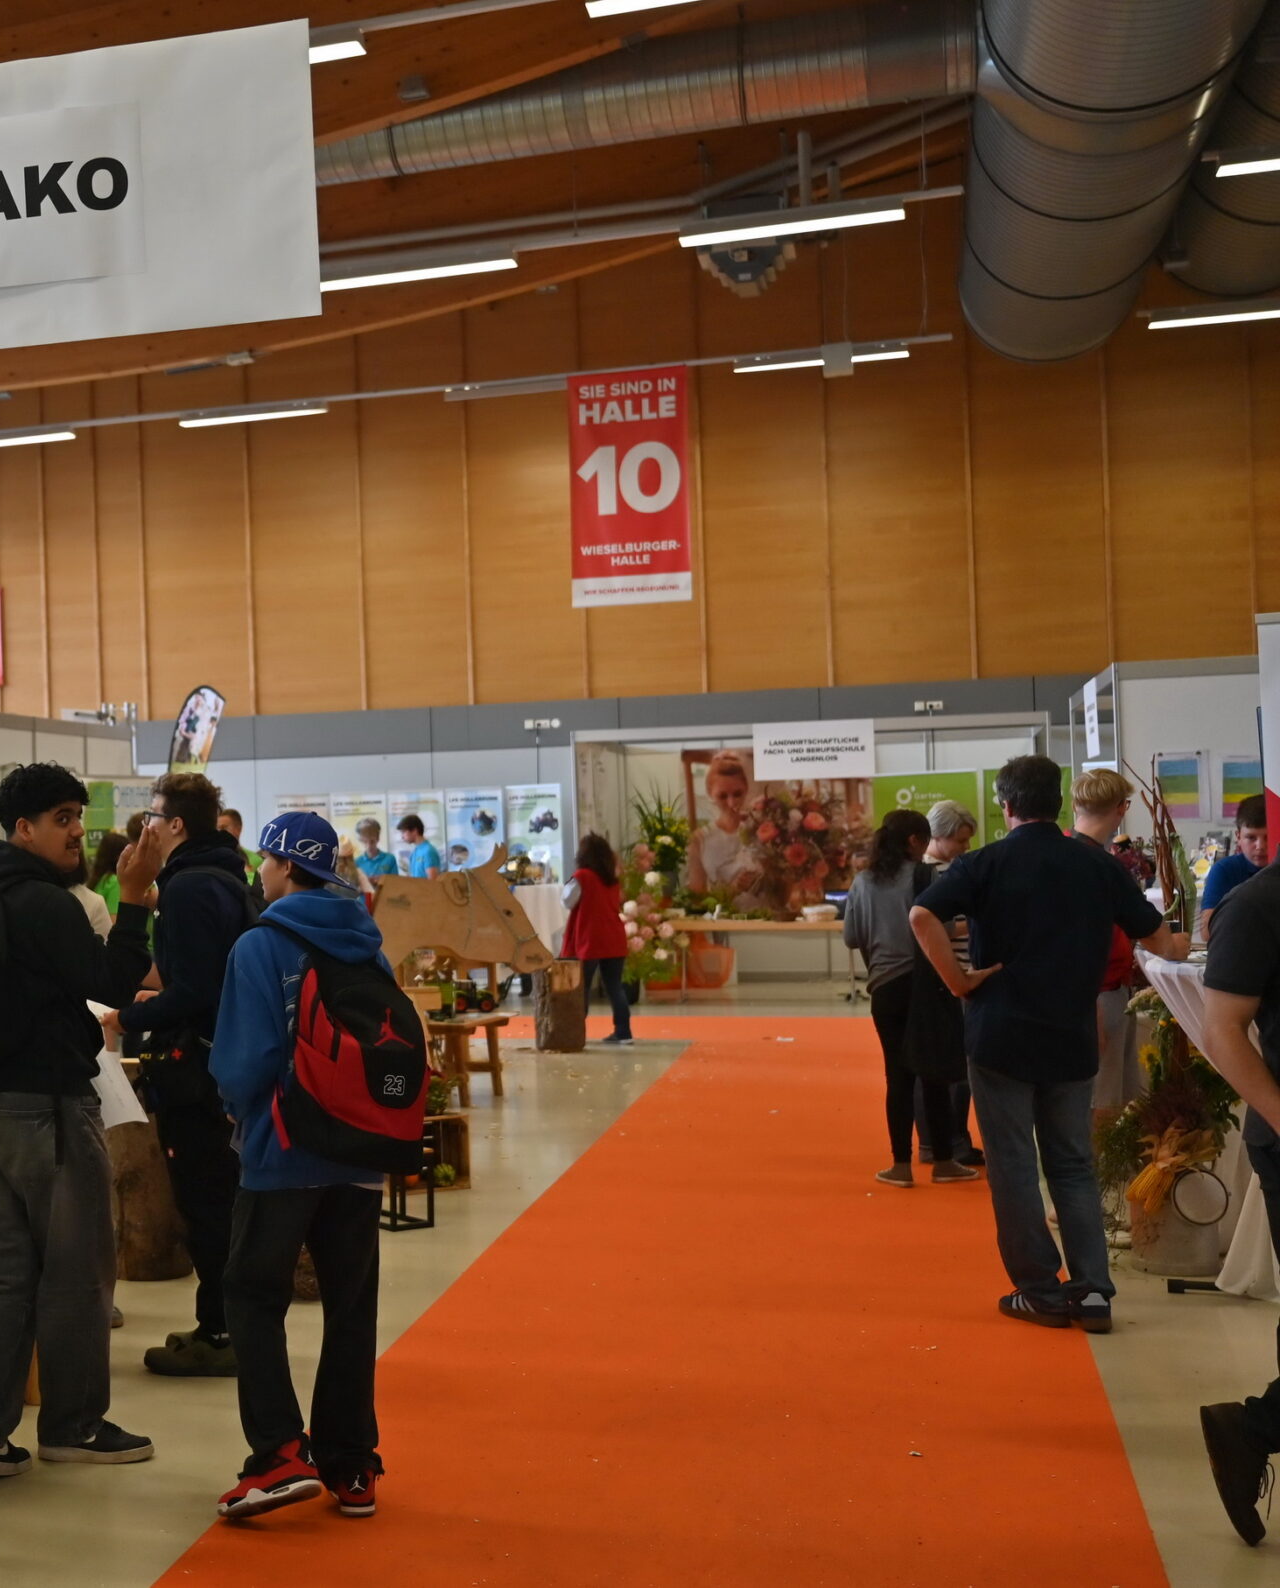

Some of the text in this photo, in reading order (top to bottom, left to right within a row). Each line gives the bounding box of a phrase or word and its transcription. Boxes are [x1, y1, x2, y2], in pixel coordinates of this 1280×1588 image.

[579, 377, 676, 400] SIE SIND IN
[578, 395, 677, 426] HALLE
[576, 440, 681, 517] 10
[580, 539, 681, 556] WIESELBURGER-
[611, 554, 651, 567] HALLE
[787, 747, 804, 755] UND
[383, 1074, 406, 1096] 23
